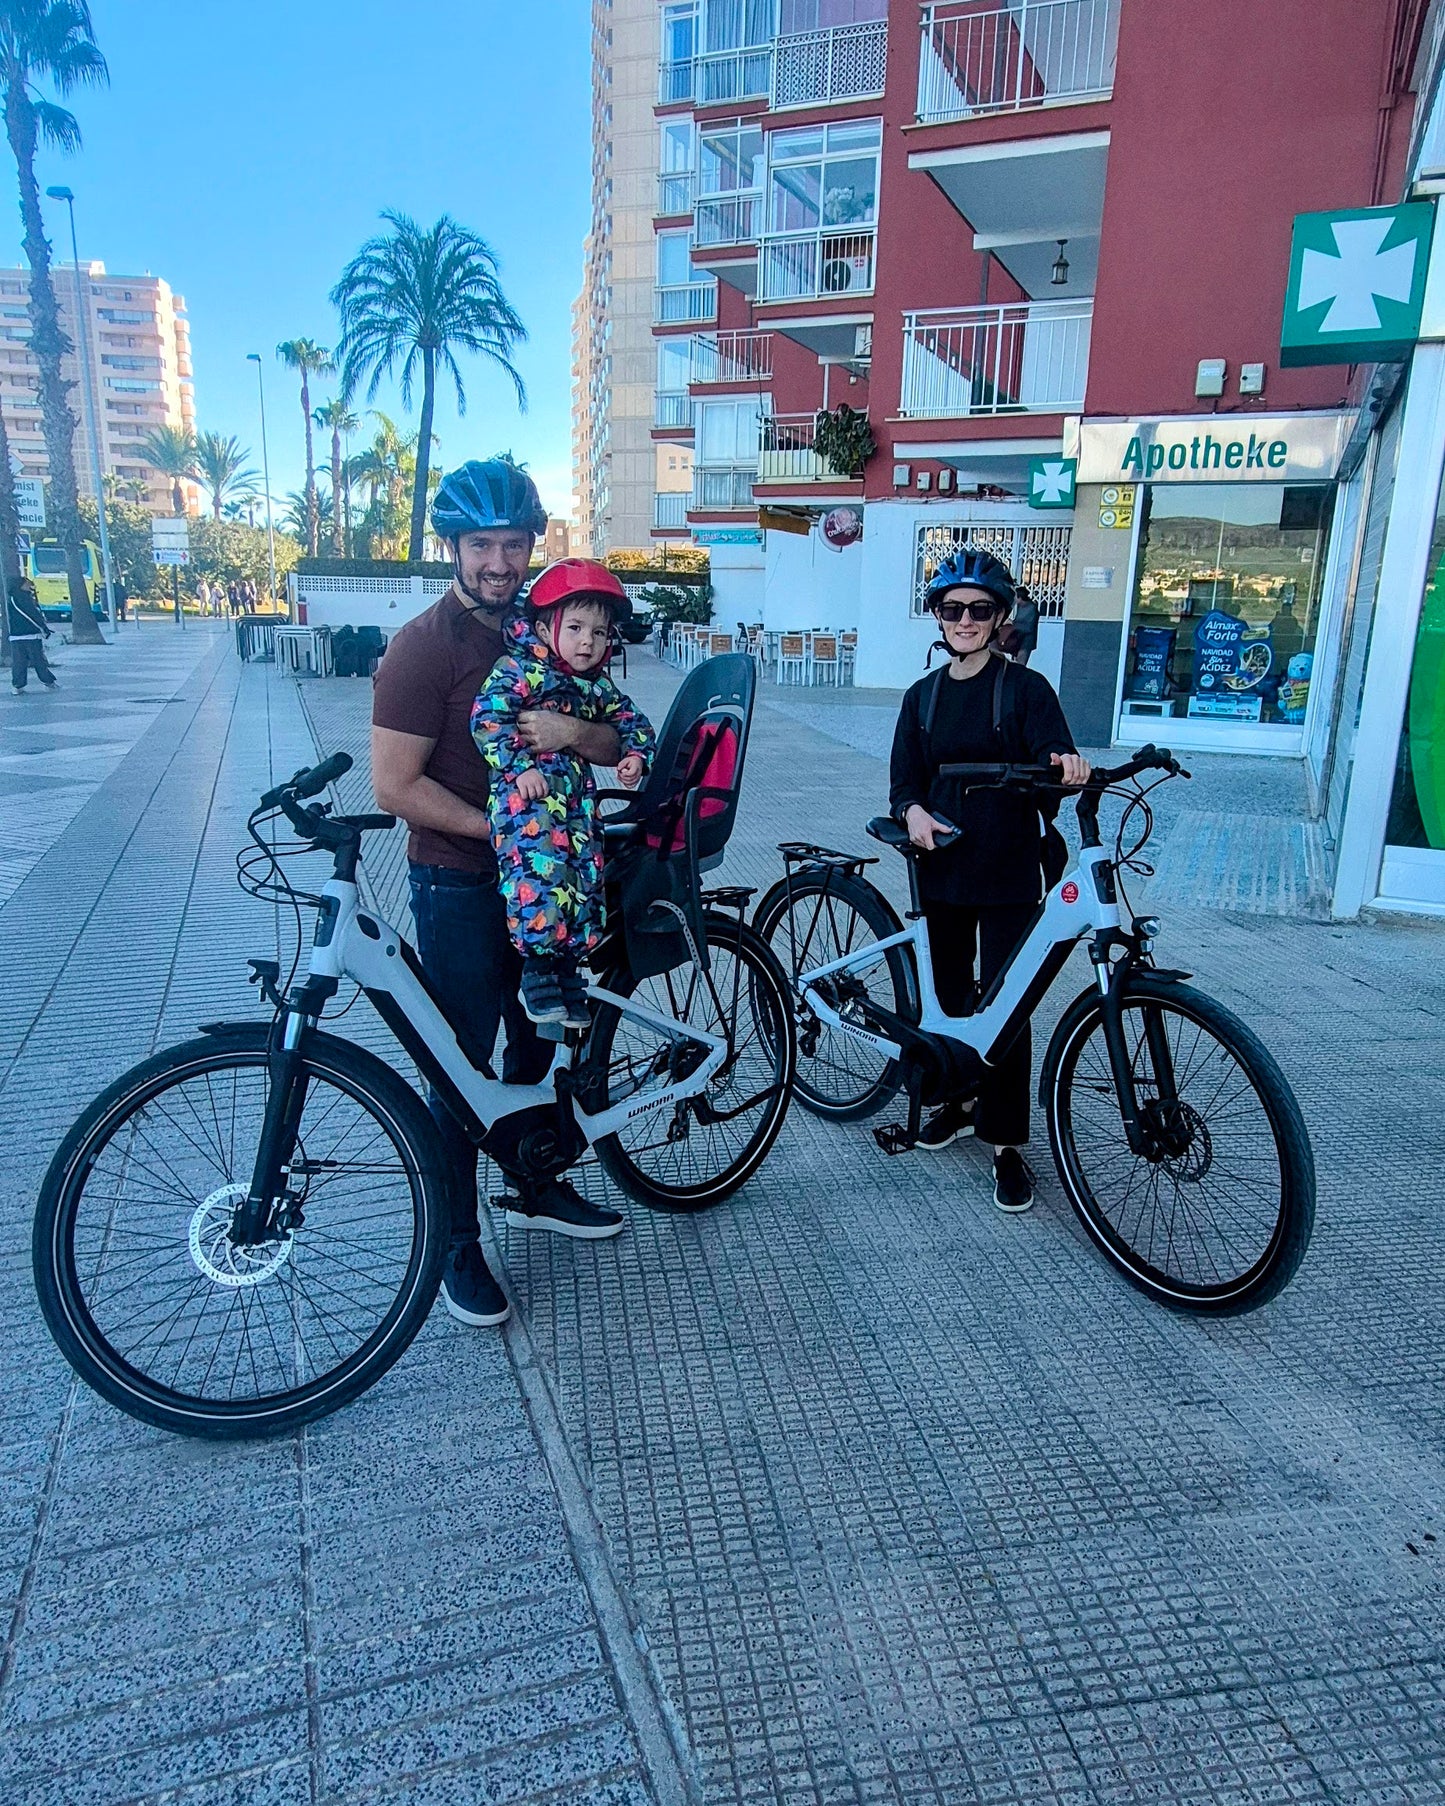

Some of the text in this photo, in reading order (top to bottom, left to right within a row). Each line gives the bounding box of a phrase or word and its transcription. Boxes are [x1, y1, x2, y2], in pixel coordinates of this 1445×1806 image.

[1121, 433, 1288, 478] Apotheke
[1205, 621, 1237, 630] Almax
[1206, 630, 1239, 641] Forte
[1138, 652, 1163, 660] NAVIDAD
[1201, 648, 1234, 656] NAVIDAD
[1137, 664, 1161, 673] ACIDEZ
[1200, 663, 1231, 672] ACIDEZ
[628, 1092, 674, 1119] WINORA
